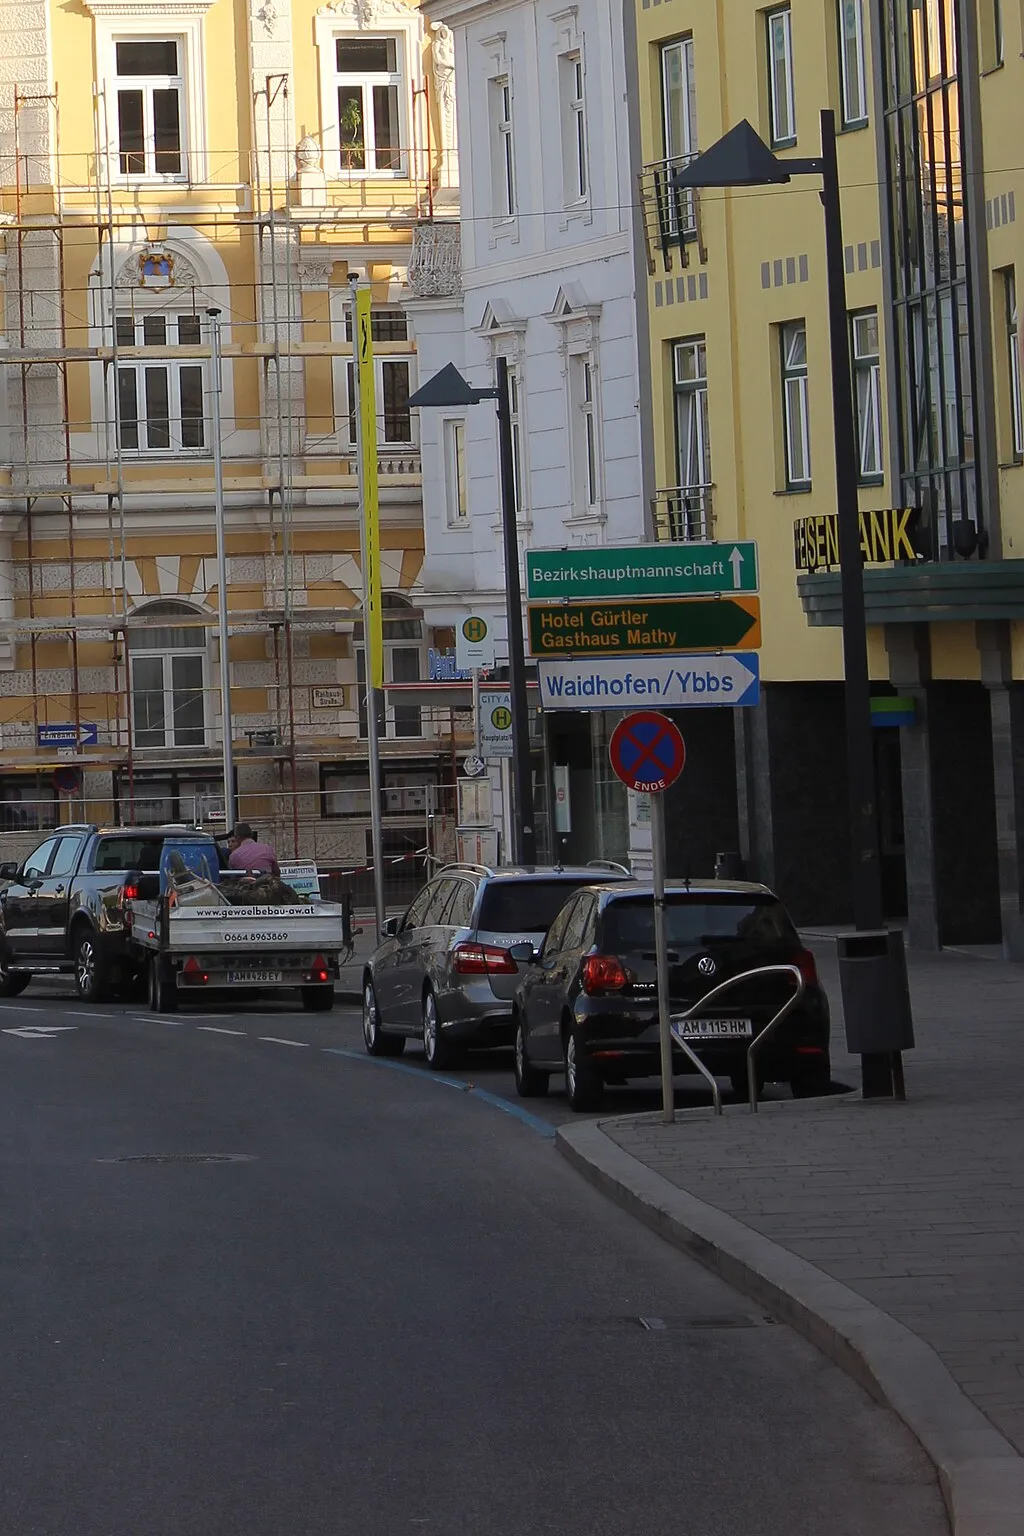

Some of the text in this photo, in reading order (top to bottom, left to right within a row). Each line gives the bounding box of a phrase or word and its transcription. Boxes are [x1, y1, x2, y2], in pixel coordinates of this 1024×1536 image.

[532, 560, 724, 583] Bezirkshauptmannschaft
[541, 609, 648, 629] Hotel Gürtler
[541, 628, 677, 648] Gasthaus Mathy
[546, 668, 734, 697] Waidhofen/Ybbs
[481, 695, 501, 704] CITY
[634, 779, 666, 791] ENDE
[196, 906, 315, 919] www.gewoelbebau-aw.at
[224, 932, 289, 942] 0664 8963869
[683, 1019, 747, 1033] AM 115 HM
